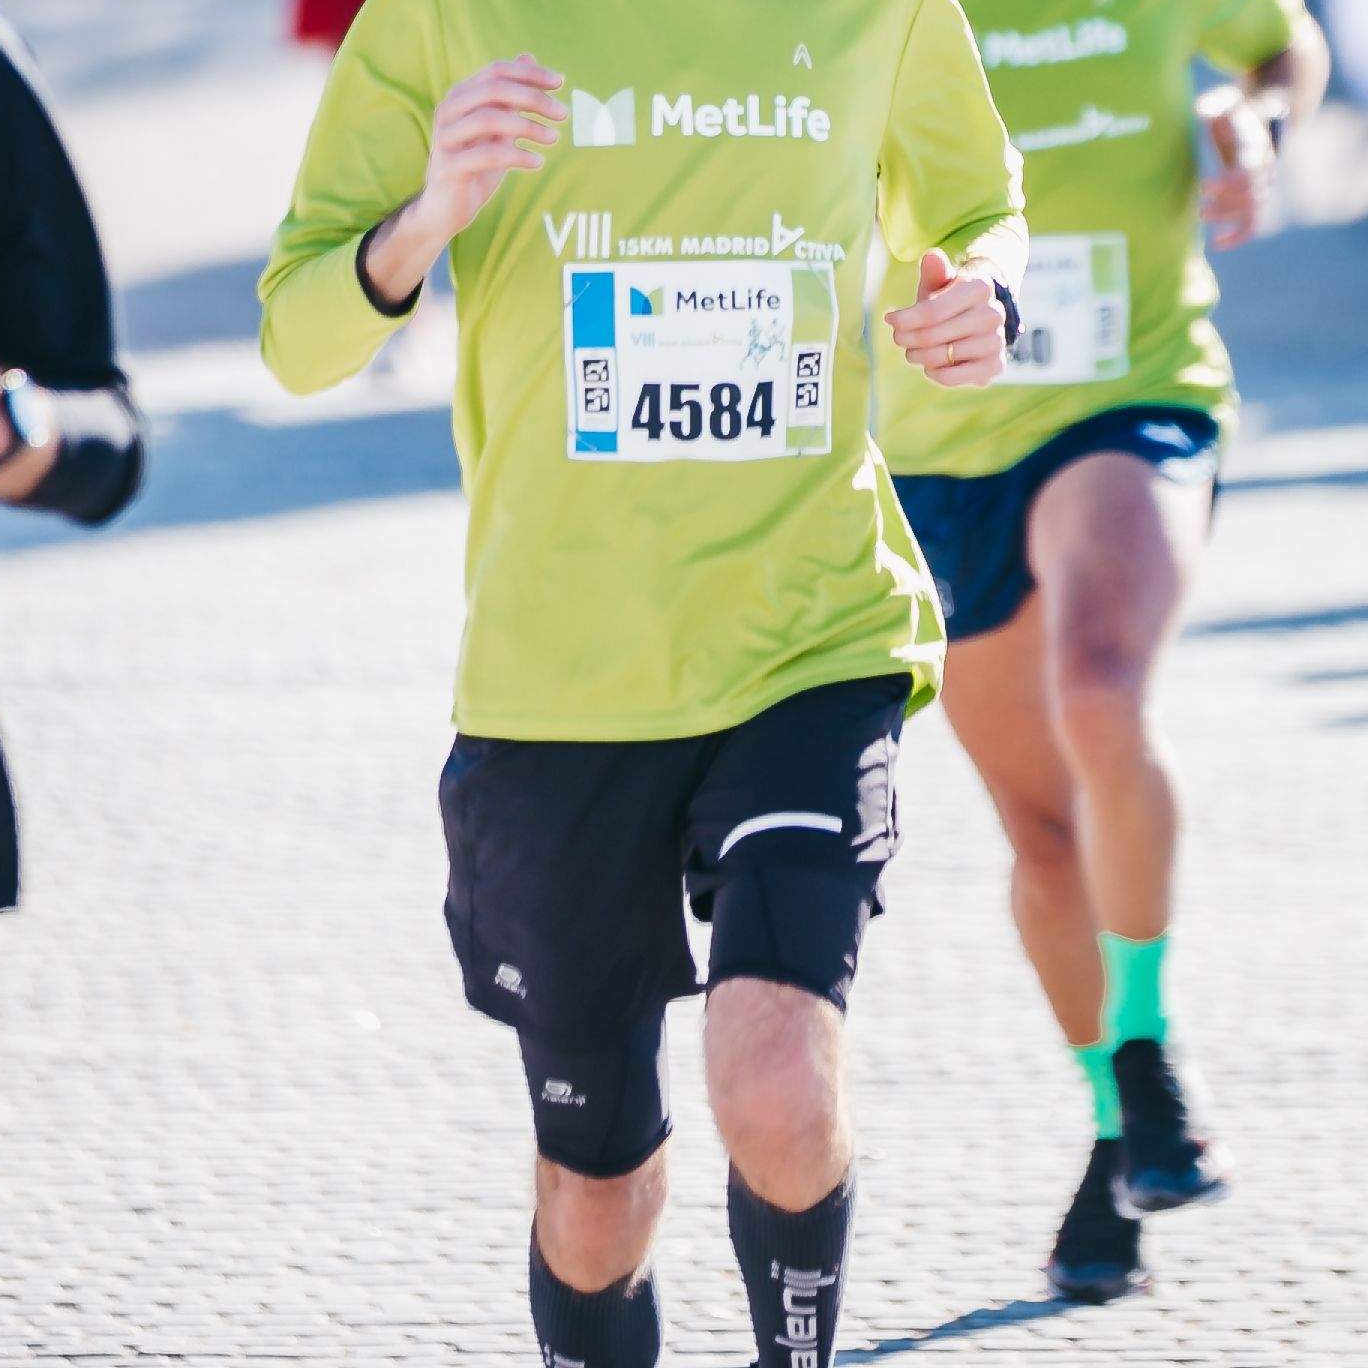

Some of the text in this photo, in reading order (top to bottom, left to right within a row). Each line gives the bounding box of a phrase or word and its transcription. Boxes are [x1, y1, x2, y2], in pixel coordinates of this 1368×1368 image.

[651, 94, 832, 142] MetLife
[543, 212, 611, 259] VIII
[618, 236, 674, 257] 15KM
[680, 236, 770, 257] MADRID
[675, 288, 781, 312] MetLife
[631, 381, 775, 442] 4584
